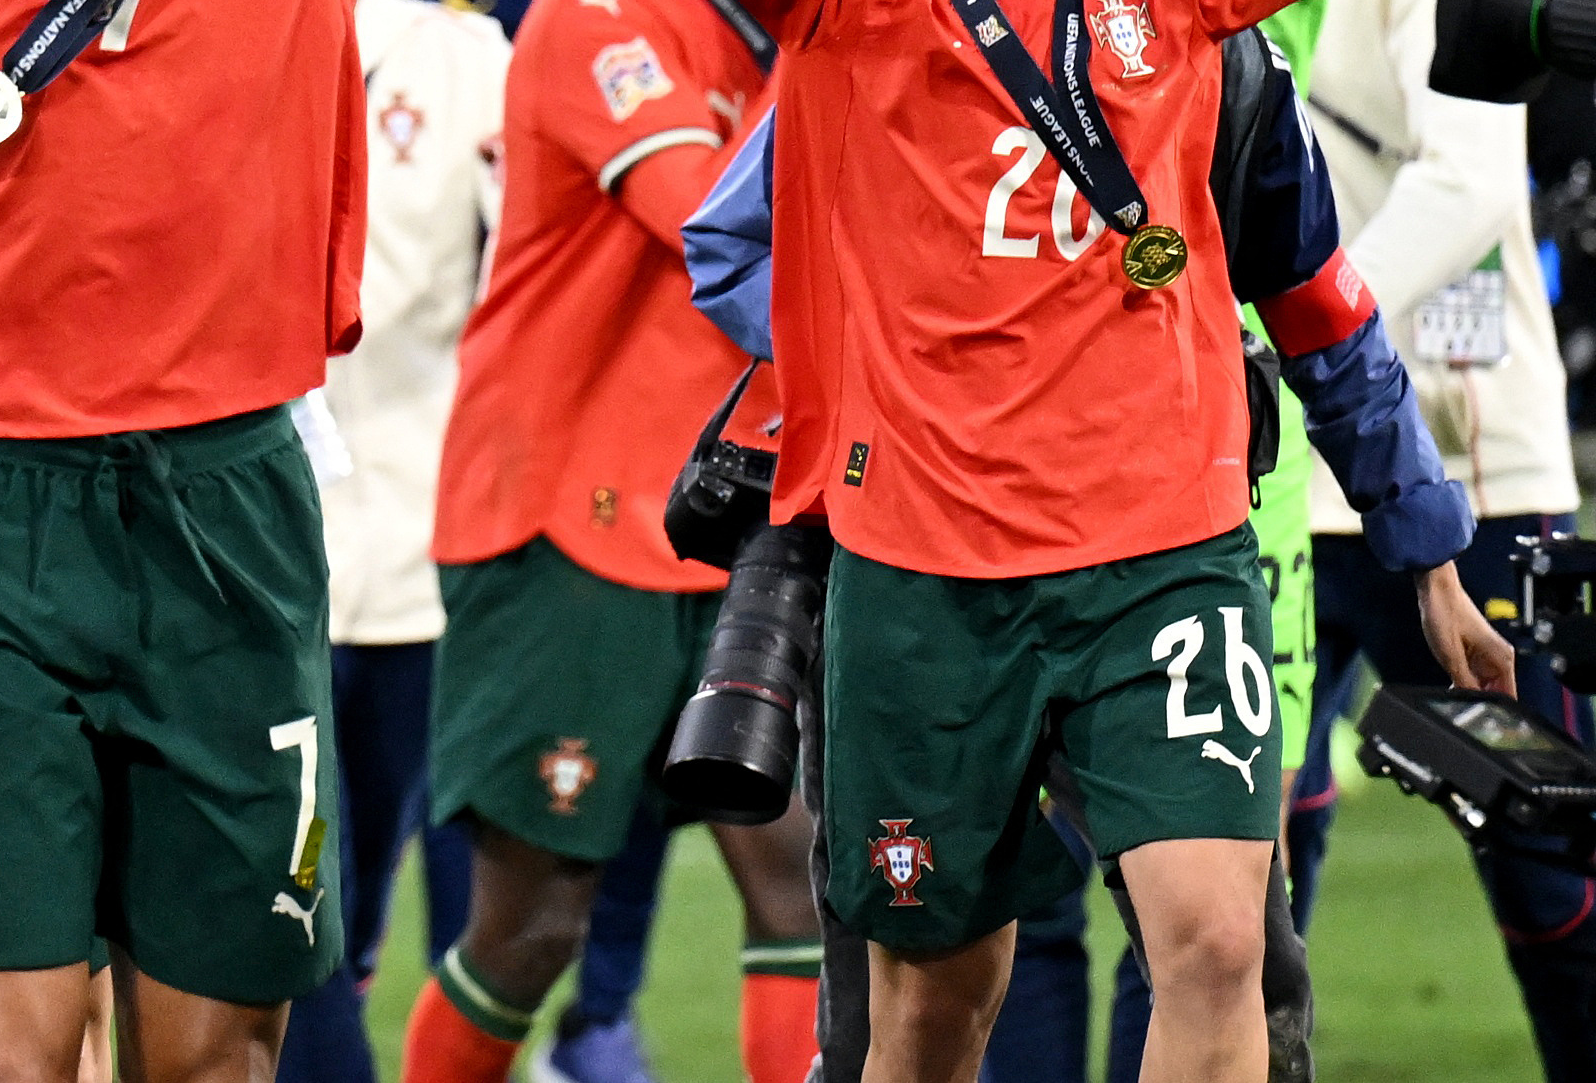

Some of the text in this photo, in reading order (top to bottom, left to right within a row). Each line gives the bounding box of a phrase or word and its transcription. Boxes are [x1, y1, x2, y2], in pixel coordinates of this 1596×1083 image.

[18, 10, 70, 72] NATIONS
[1065, 12, 1079, 43] UEFA
[1029, 95, 1072, 150] LEAGUE
[1070, 89, 1102, 148] LEAGUE
[1151, 606, 1272, 739] 26
[269, 715, 318, 877] 7
